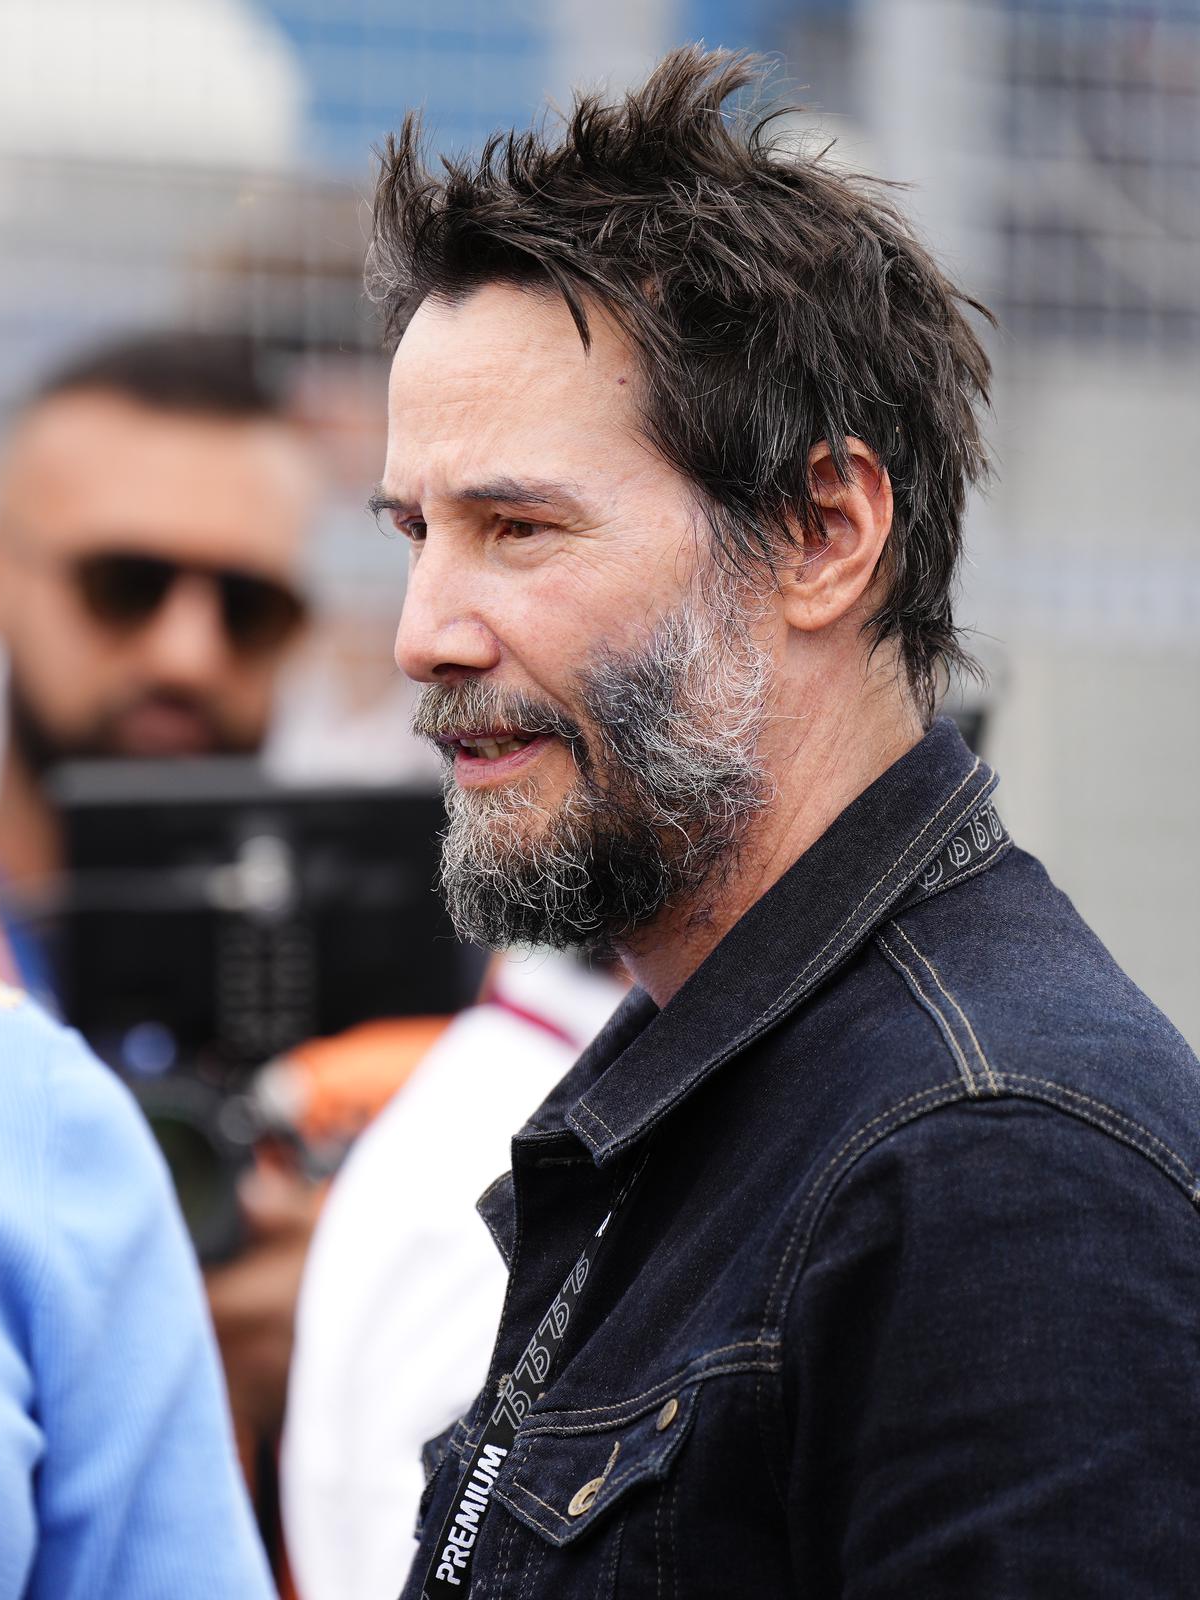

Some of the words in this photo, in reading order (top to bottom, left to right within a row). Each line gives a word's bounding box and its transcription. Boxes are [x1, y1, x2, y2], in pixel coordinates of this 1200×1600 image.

[435, 1443, 508, 1585] PREMIUM
[491, 1380, 531, 1430] 75
[514, 1337, 551, 1384] 75
[538, 1292, 570, 1339] 75
[562, 1250, 589, 1294] 75
